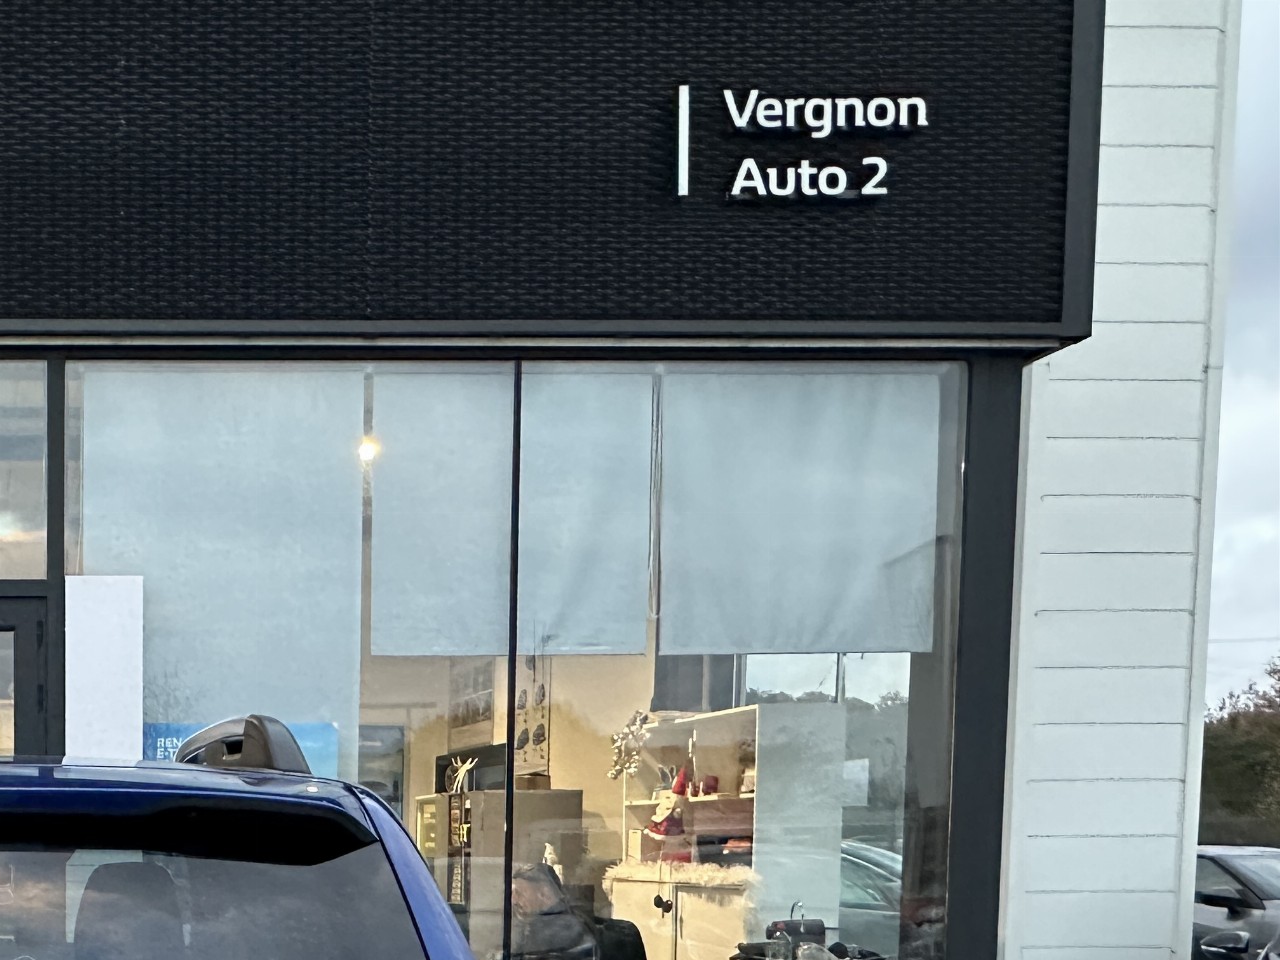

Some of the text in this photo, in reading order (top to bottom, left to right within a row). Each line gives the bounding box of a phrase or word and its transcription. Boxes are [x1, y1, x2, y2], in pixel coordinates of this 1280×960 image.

[723, 89, 929, 138] Vergnon
[731, 157, 888, 195] Auto 2
